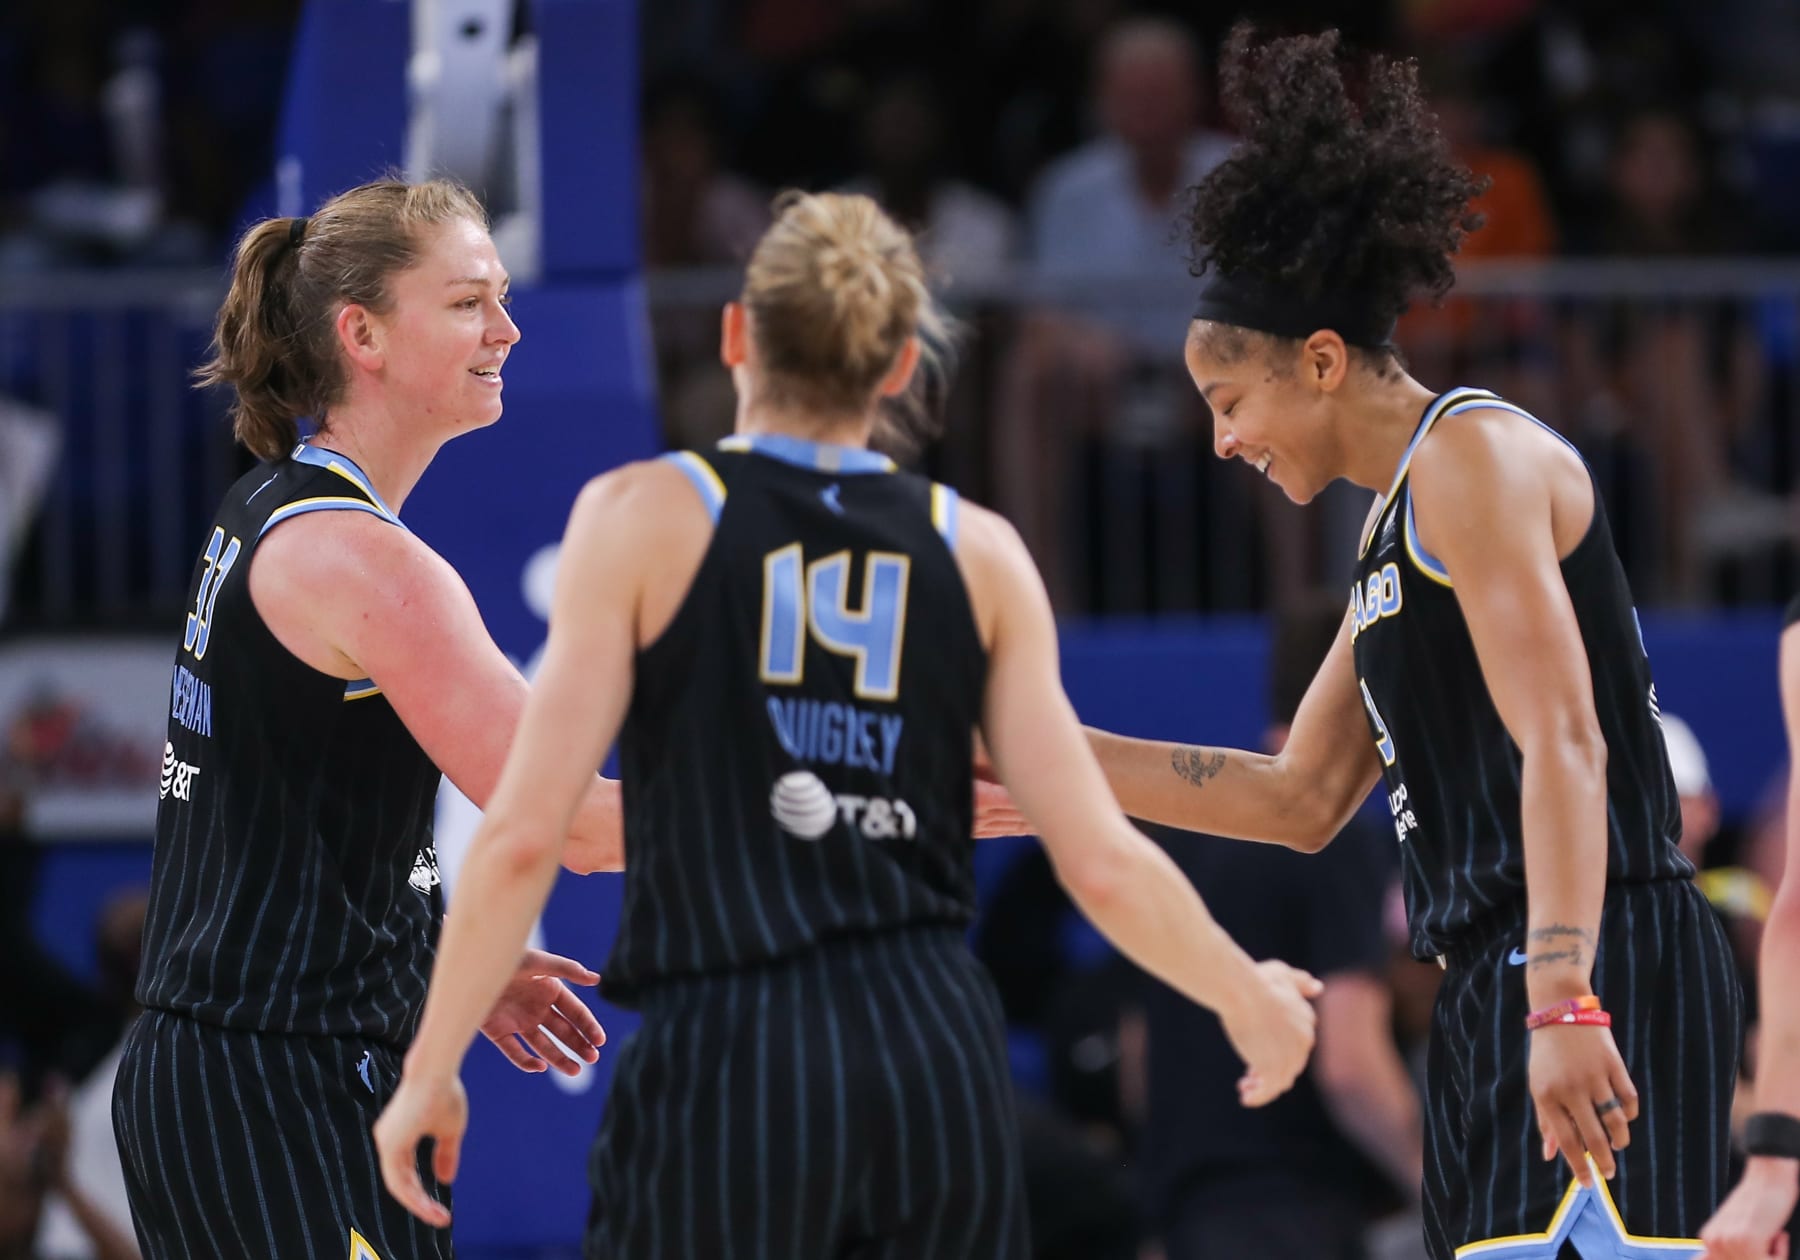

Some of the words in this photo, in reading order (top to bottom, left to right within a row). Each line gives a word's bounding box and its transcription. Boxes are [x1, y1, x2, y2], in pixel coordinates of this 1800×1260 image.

[184, 525, 241, 660] 33
[759, 541, 911, 702] 14
[1350, 562, 1403, 646] AGO
